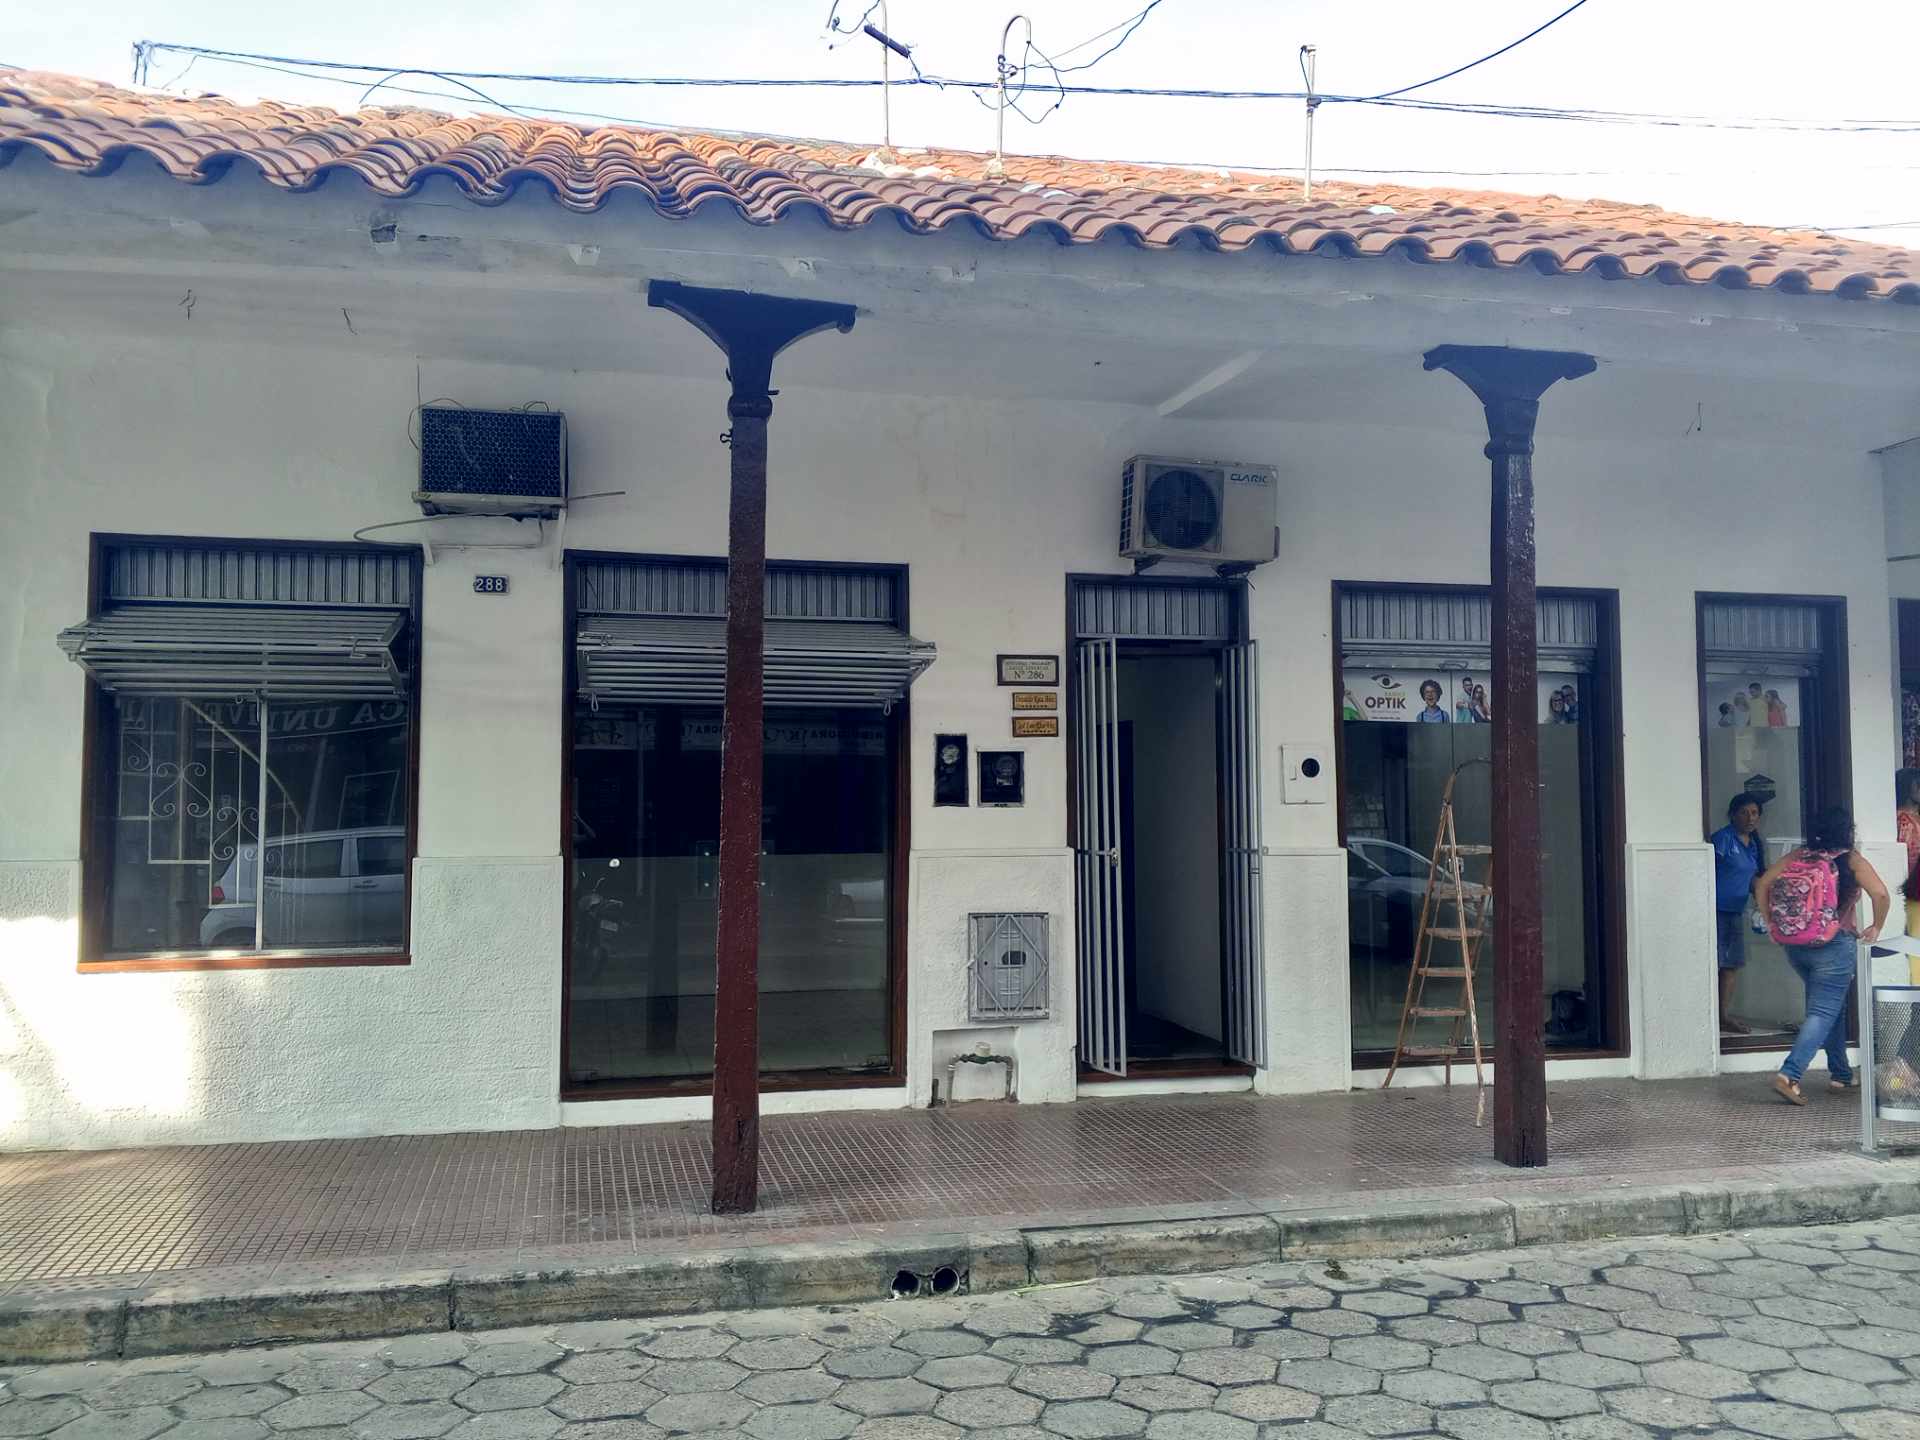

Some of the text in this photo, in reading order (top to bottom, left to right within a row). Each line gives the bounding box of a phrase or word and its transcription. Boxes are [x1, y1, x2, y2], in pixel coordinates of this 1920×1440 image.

[475, 578, 503, 592] 288
[1028, 670, 1045, 680] 286
[1365, 696, 1407, 710] OPTIK
